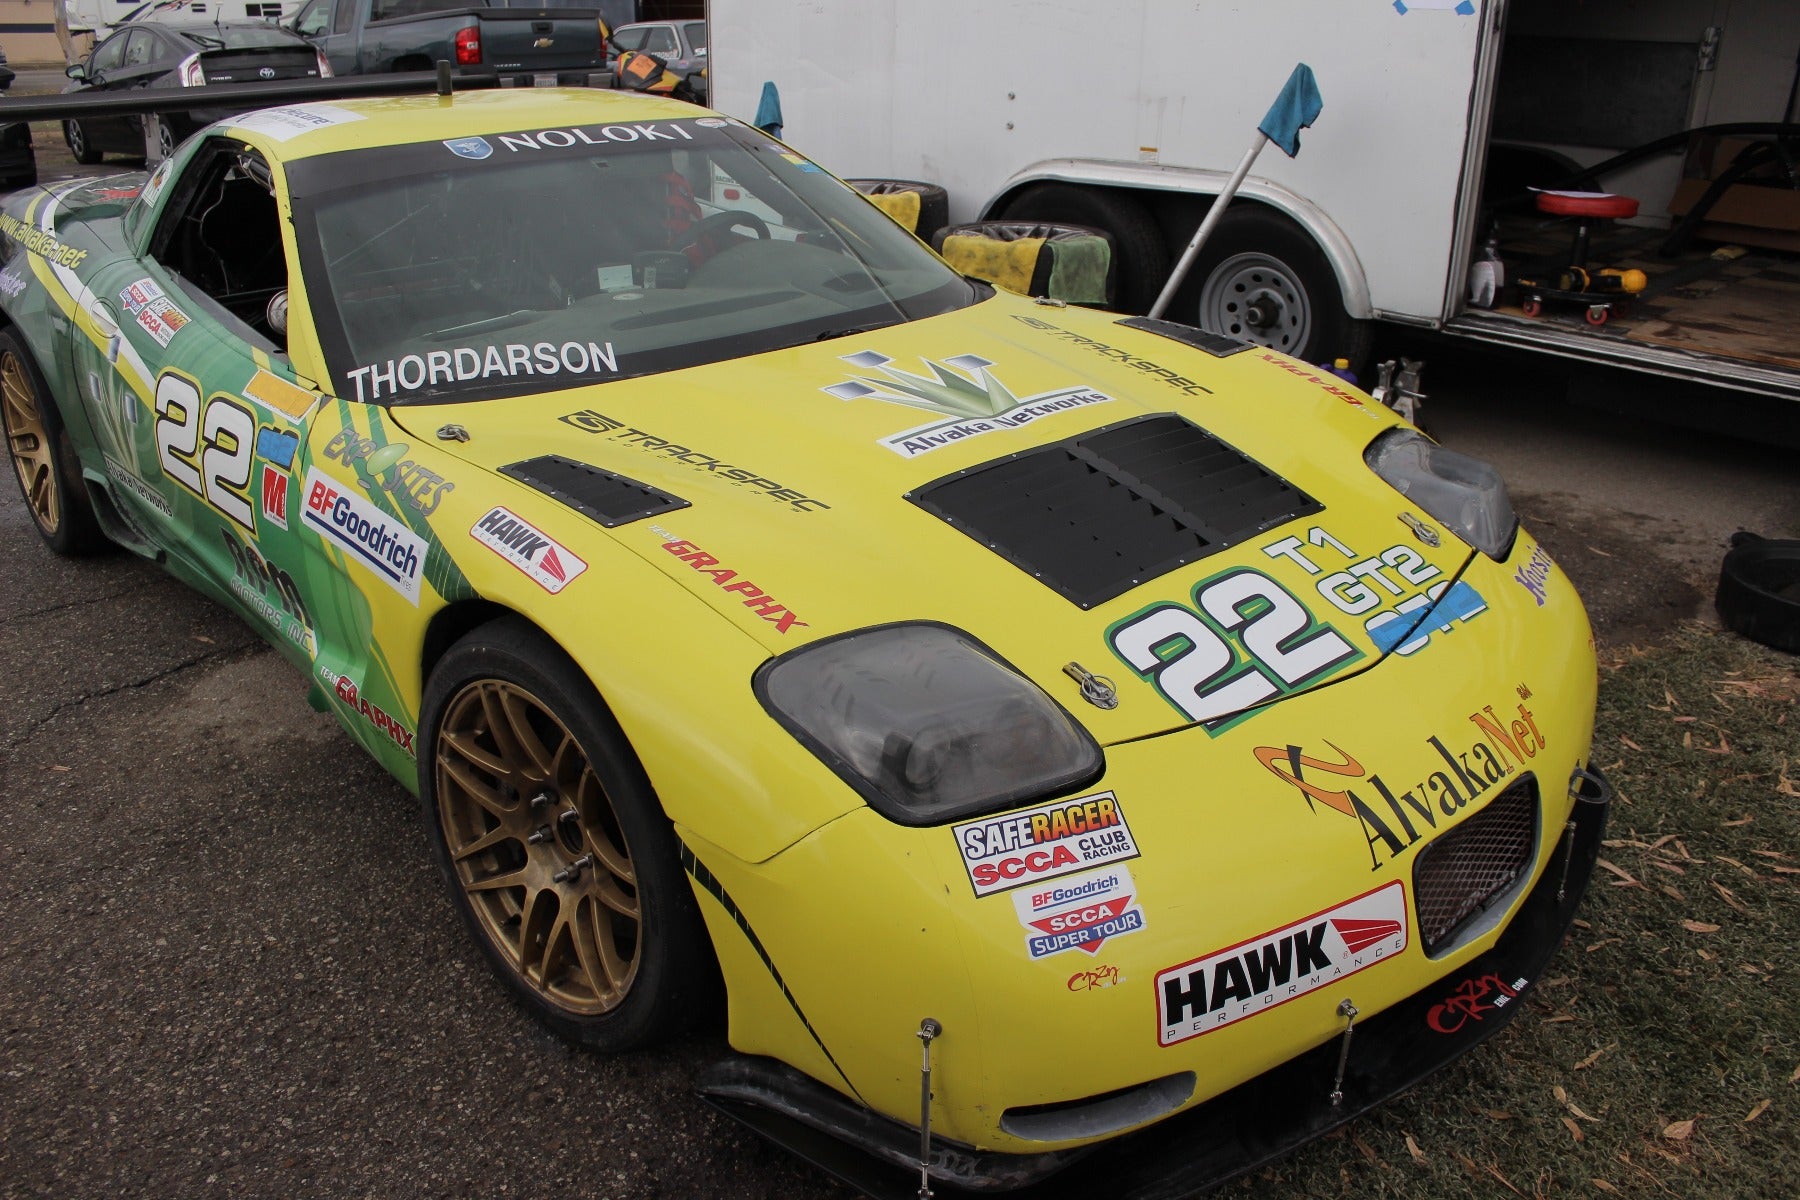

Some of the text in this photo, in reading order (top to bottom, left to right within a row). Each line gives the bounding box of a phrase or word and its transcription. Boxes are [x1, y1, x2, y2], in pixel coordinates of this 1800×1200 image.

[498, 124, 693, 152] NOLOKI
[139, 310, 162, 335] SCCA
[347, 341, 619, 403] THORDARSON
[155, 371, 256, 536] 22
[902, 392, 1108, 455] Alvaka Networks
[617, 427, 832, 512] TRACKSPEC
[308, 479, 418, 579] BFGoodrich
[478, 509, 550, 561] HAWK
[1262, 527, 1358, 575] T1
[661, 540, 810, 635] GRAPHX
[1316, 545, 1443, 615] GT2
[1110, 571, 1359, 730] 22
[335, 675, 416, 758] GRAPHX
[1346, 703, 1546, 872] AlvakaNet
[964, 797, 1121, 861] SAFERACER
[972, 830, 1126, 887] SCCA CLUB
[1082, 842, 1131, 861] RACING
[1031, 875, 1119, 908] BFGoodrich
[1050, 905, 1114, 932] SCCA
[1034, 914, 1138, 955] SUPER TOUR
[1164, 920, 1332, 1027] HAWK
[1167, 939, 1402, 1040] PERFORMANCE
